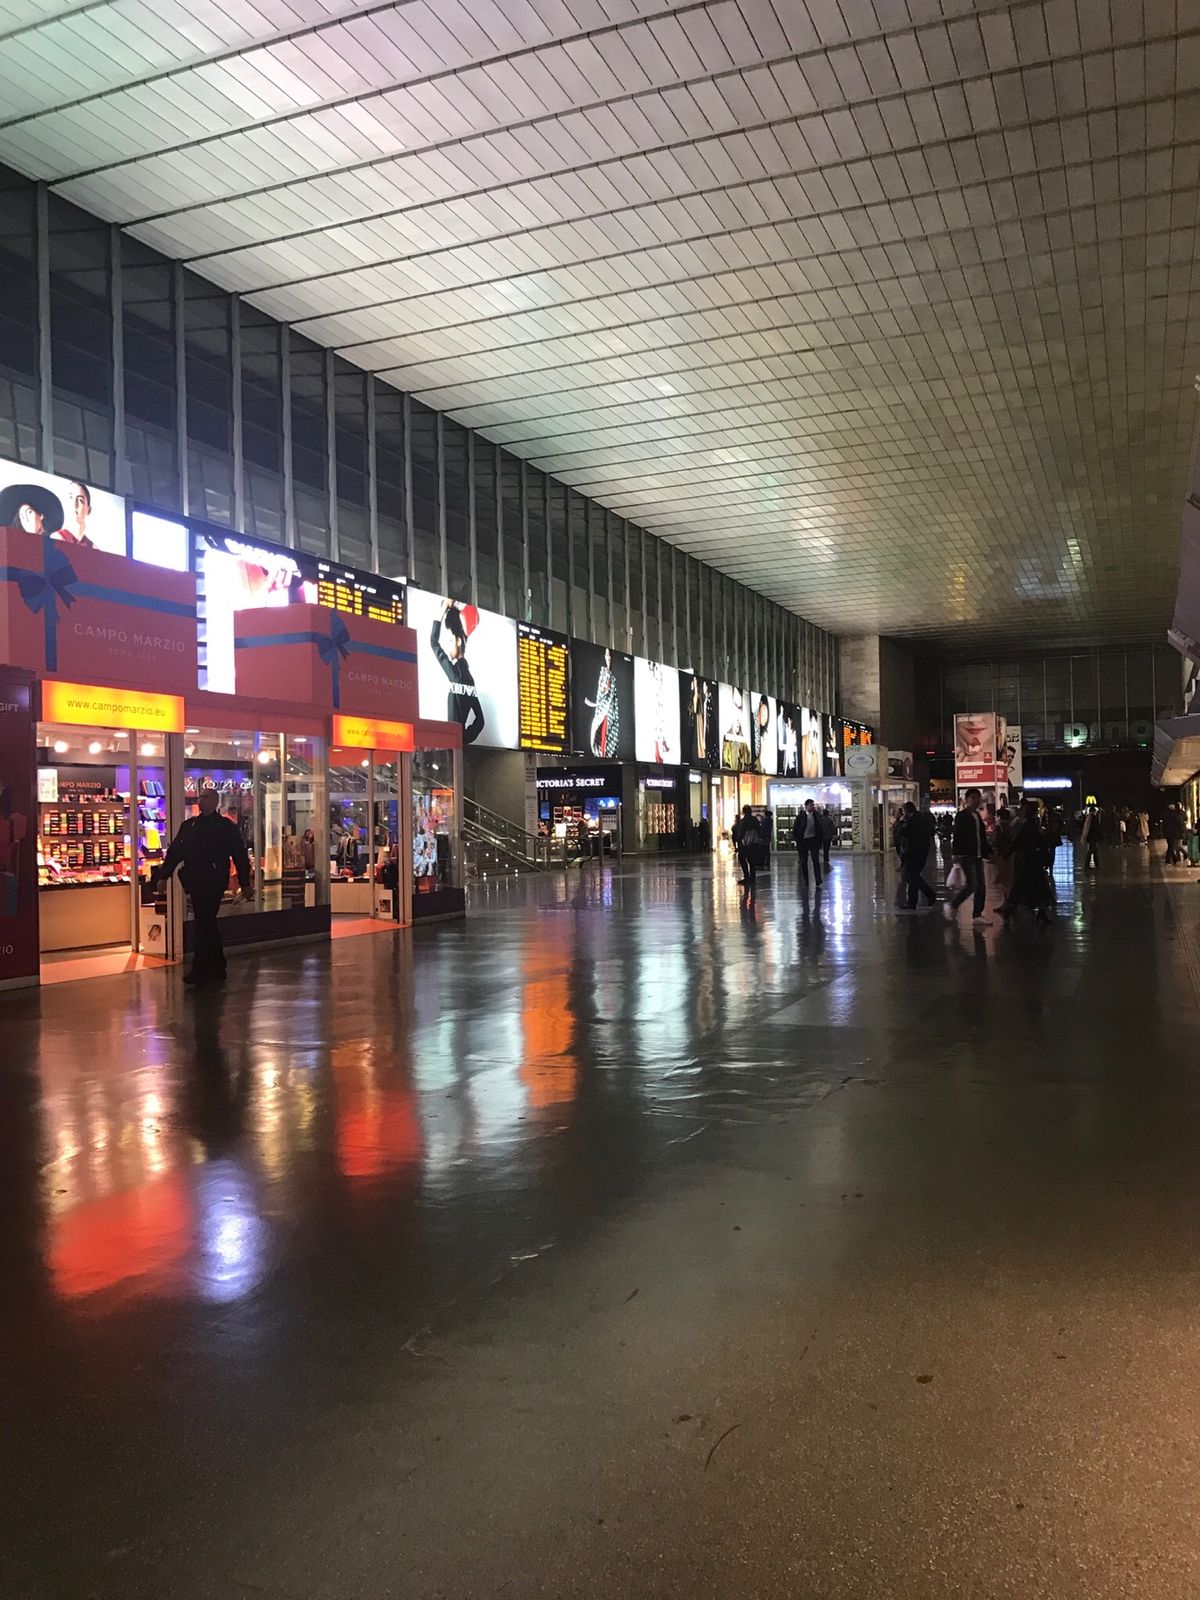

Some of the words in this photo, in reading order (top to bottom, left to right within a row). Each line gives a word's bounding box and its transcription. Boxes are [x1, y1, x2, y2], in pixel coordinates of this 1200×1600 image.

[74, 623, 127, 642] CAMPO
[133, 632, 186, 653] MARZIO
[348, 671, 379, 687] CAMPO
[382, 678, 412, 691] MARZIO
[0, 702, 20, 713] GIFT
[66, 698, 166, 717] www.campomarzio.eu
[536, 779, 574, 789] ICTORIA'S
[575, 777, 606, 787] SECRET
[0, 944, 14, 955] IO
